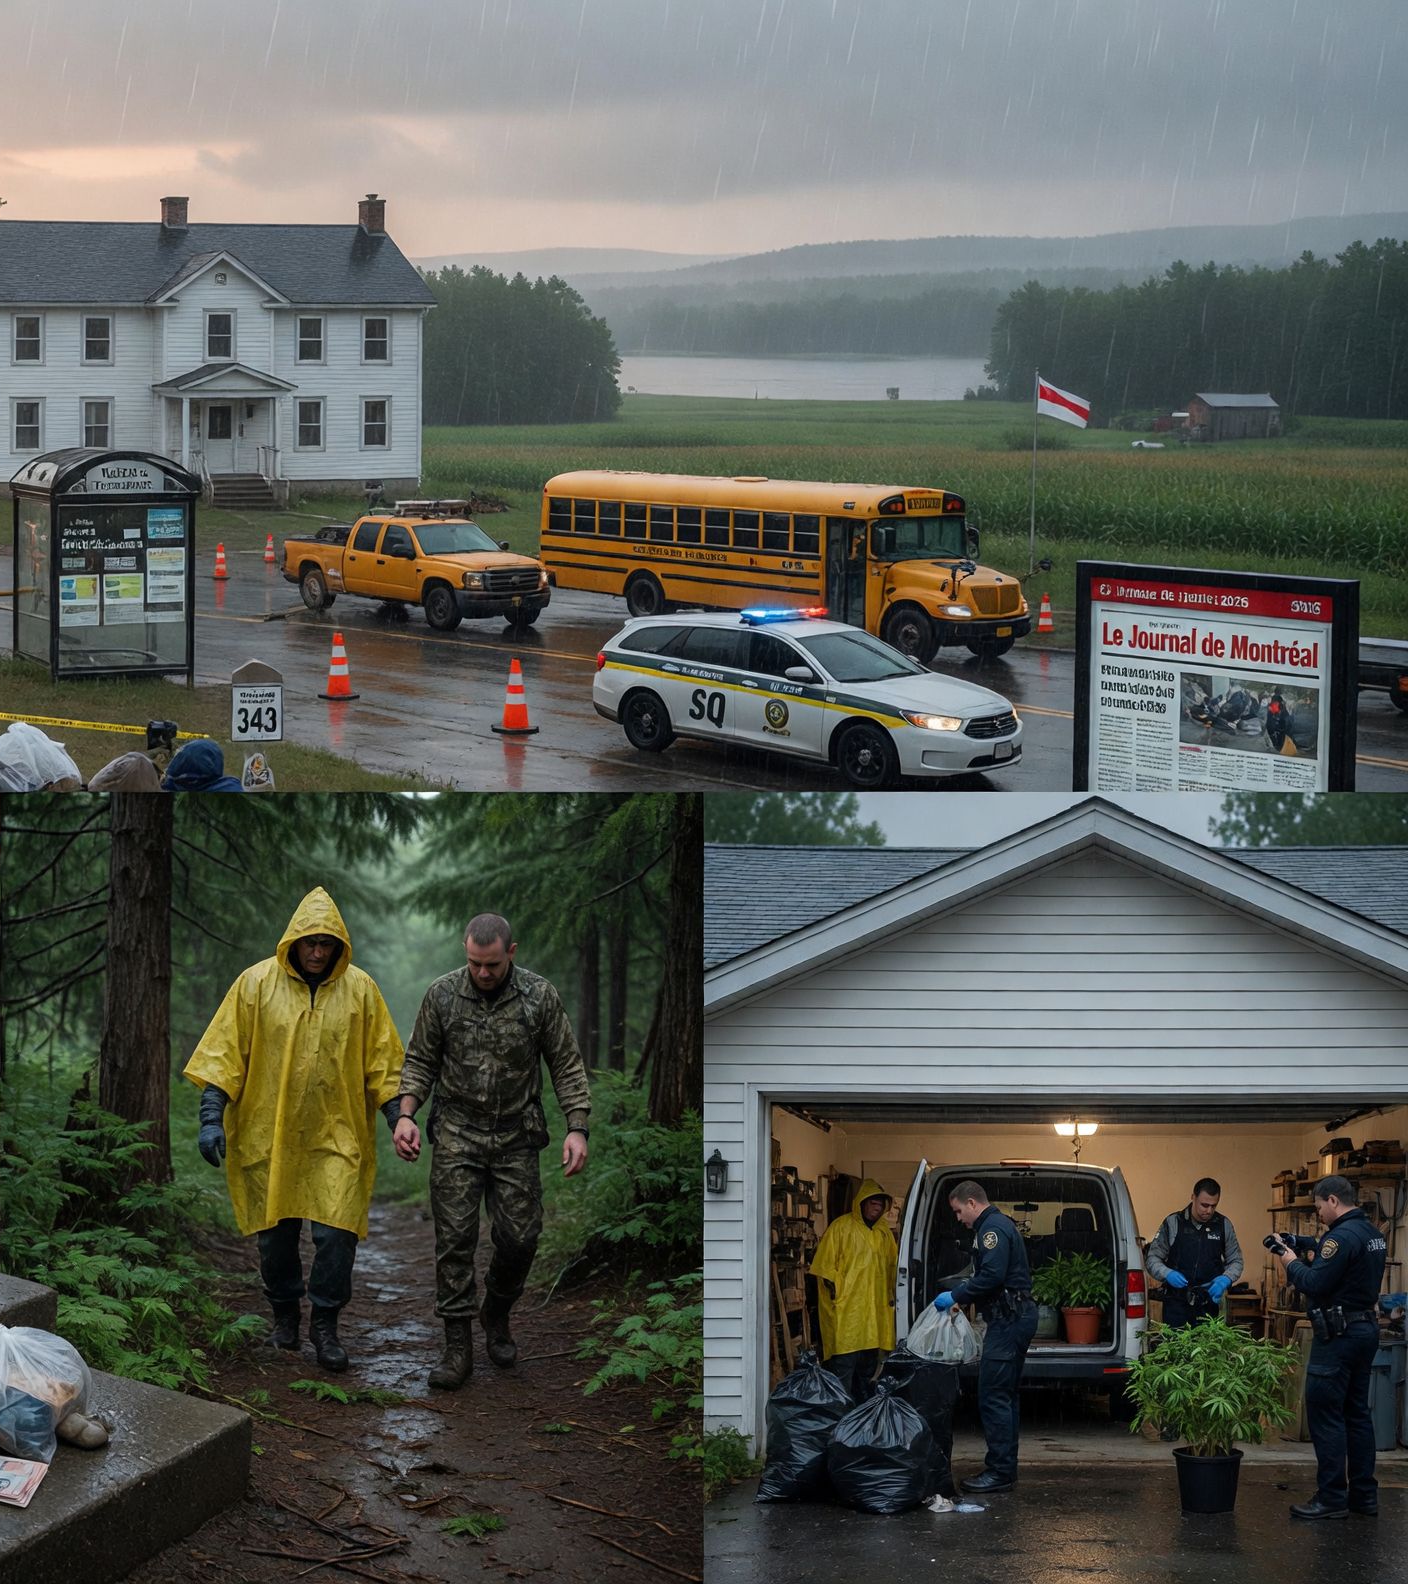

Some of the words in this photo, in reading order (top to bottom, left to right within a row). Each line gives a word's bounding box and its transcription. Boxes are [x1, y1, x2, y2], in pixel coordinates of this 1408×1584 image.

[1103, 621, 1123, 646] Le
[1128, 624, 1197, 655] Journal
[1201, 631, 1225, 658] de
[1231, 634, 1318, 669] Montréal
[237, 706, 277, 733] 343
[689, 688, 726, 729] SQ
